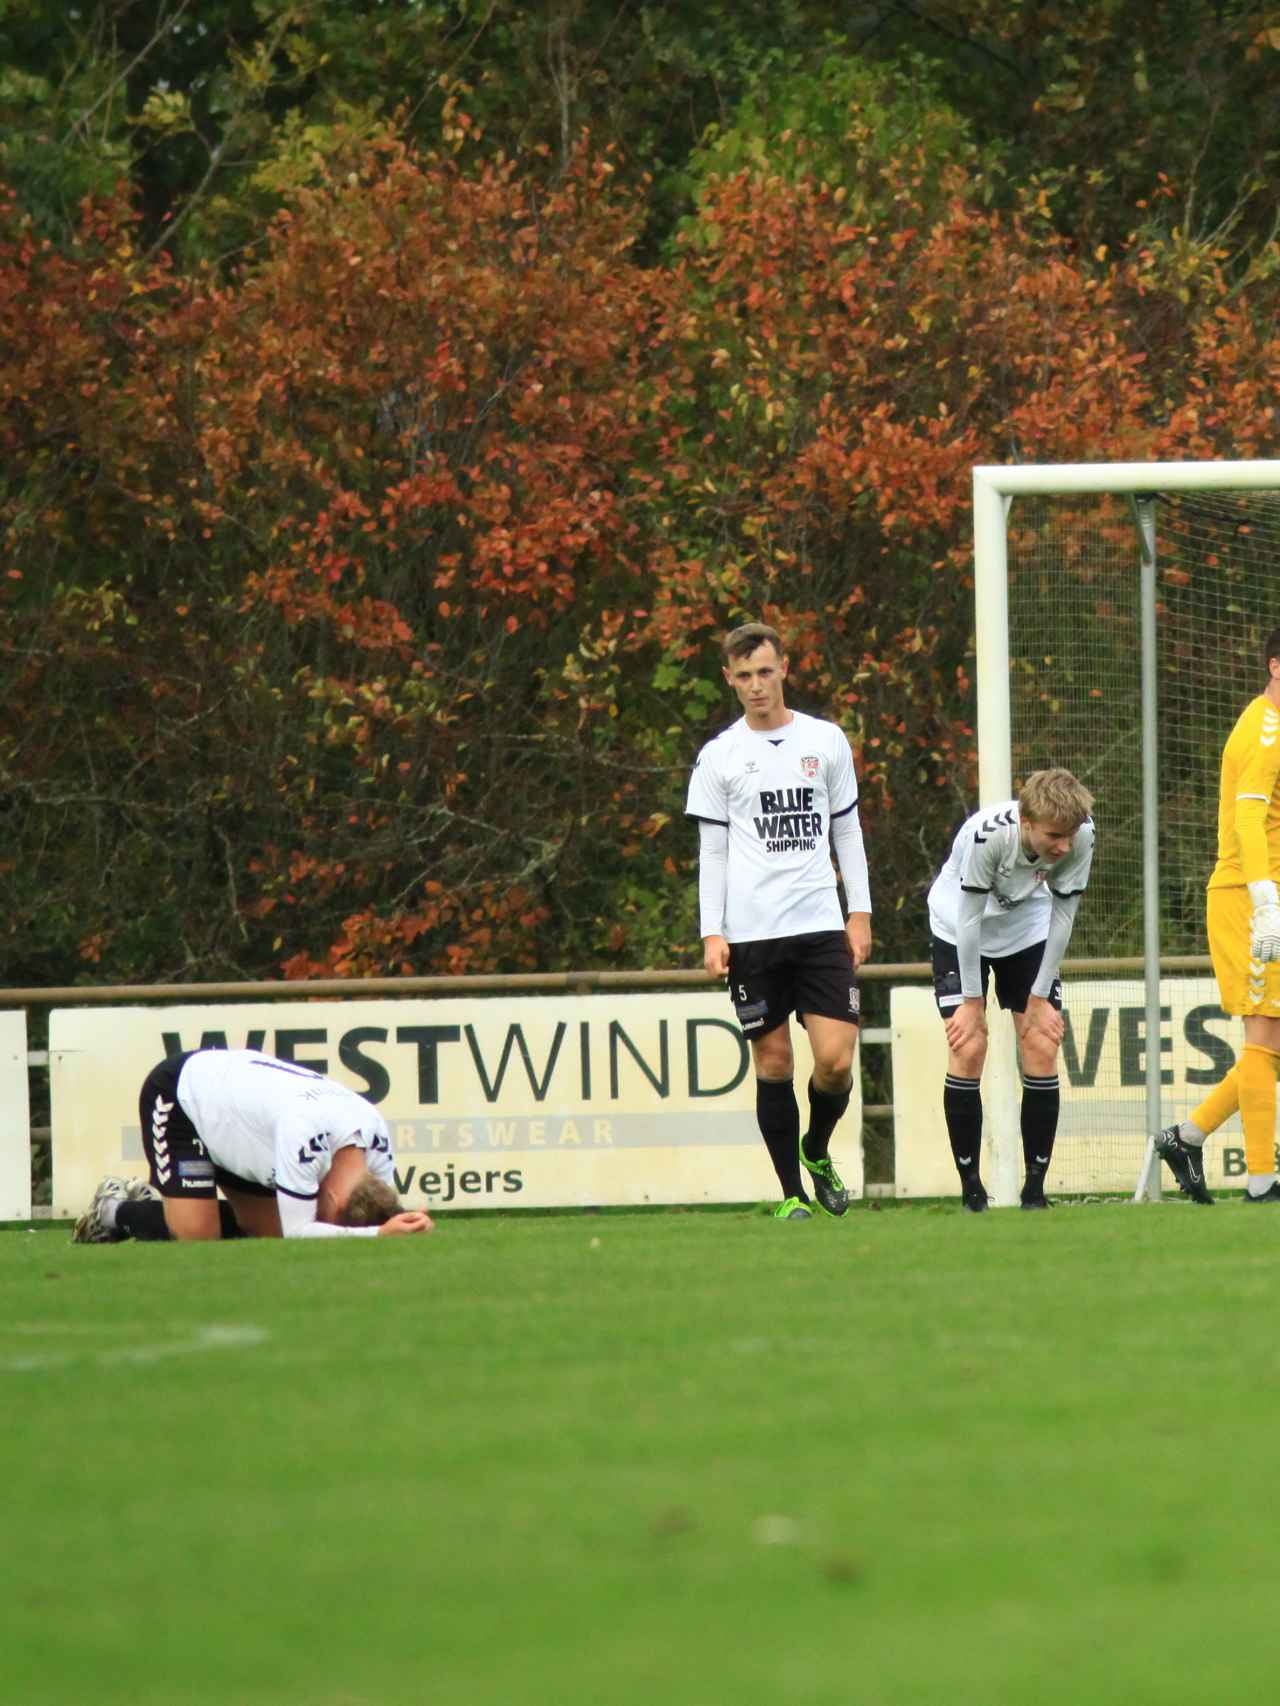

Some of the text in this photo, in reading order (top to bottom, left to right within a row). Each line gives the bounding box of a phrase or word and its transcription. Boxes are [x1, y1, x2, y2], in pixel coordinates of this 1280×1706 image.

[759, 787, 815, 816] BLUE
[752, 811, 823, 841] WATER
[765, 838, 817, 854] SHIPPING
[738, 984, 748, 1001] 5
[396, 1119, 614, 1150] RTSWEAR
[393, 1163, 524, 1202] Vejers
